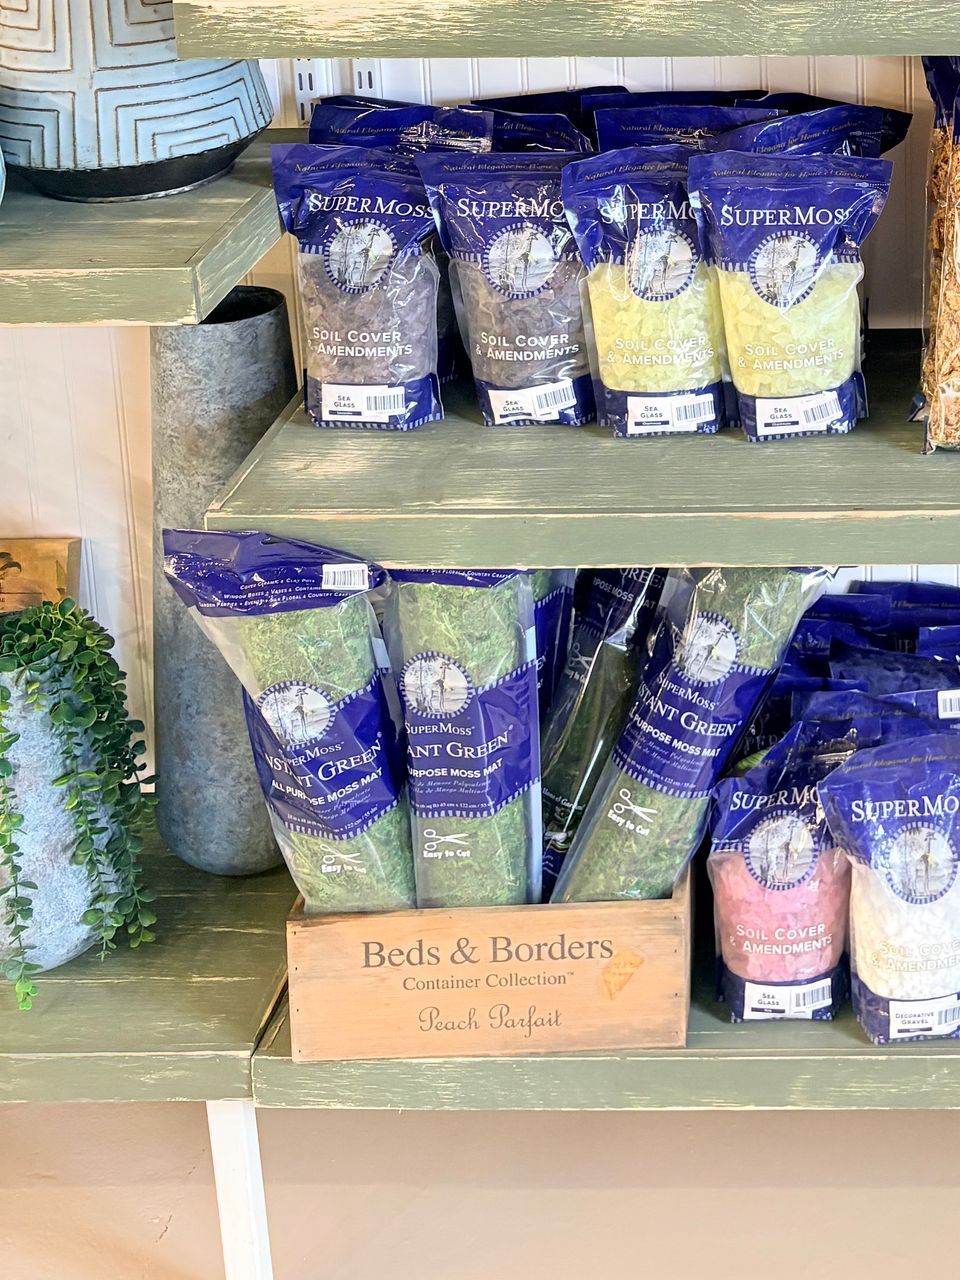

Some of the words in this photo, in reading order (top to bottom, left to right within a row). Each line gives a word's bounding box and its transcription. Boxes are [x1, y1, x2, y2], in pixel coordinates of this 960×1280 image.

[313, 327, 342, 342] SOIL
[348, 330, 401, 342] COVER
[481, 331, 509, 347] SOIL
[516, 334, 569, 347] COVER
[615, 338, 648, 350] SOIL
[654, 336, 706, 350] COVER
[318, 344, 412, 357] AMENDMENTS
[487, 344, 579, 361] AMENDMENTS
[744, 344, 778, 356] SOIL
[786, 338, 834, 356] COVER
[622, 348, 714, 366] AMENDMENTS
[752, 349, 844, 370] AMENDMENTS
[770, 412, 792, 420] GLASS
[680, 711, 736, 737] GREEN
[446, 731, 509, 758] GREEN
[633, 714, 671, 744] PURPOSE
[672, 739, 701, 755] MOSS
[702, 748, 720, 757] MAT
[318, 739, 381, 781] GREEN
[451, 768, 480, 777] MOSS
[484, 758, 502, 776] MAT
[327, 781, 359, 803] MOSS
[361, 767, 382, 786] MAT
[424, 850, 442, 859] Easy
[736, 924, 769, 940] SOIL
[775, 924, 825, 940] COVER
[361, 940, 440, 969] Beds
[450, 937, 481, 965] &
[489, 934, 614, 963] Borders
[743, 935, 832, 954] AMENDMENTS
[402, 976, 480, 992] Container
[758, 998, 780, 1006] GLASS
[418, 1006, 480, 1032] Peach
[489, 1003, 562, 1038] Parfait
